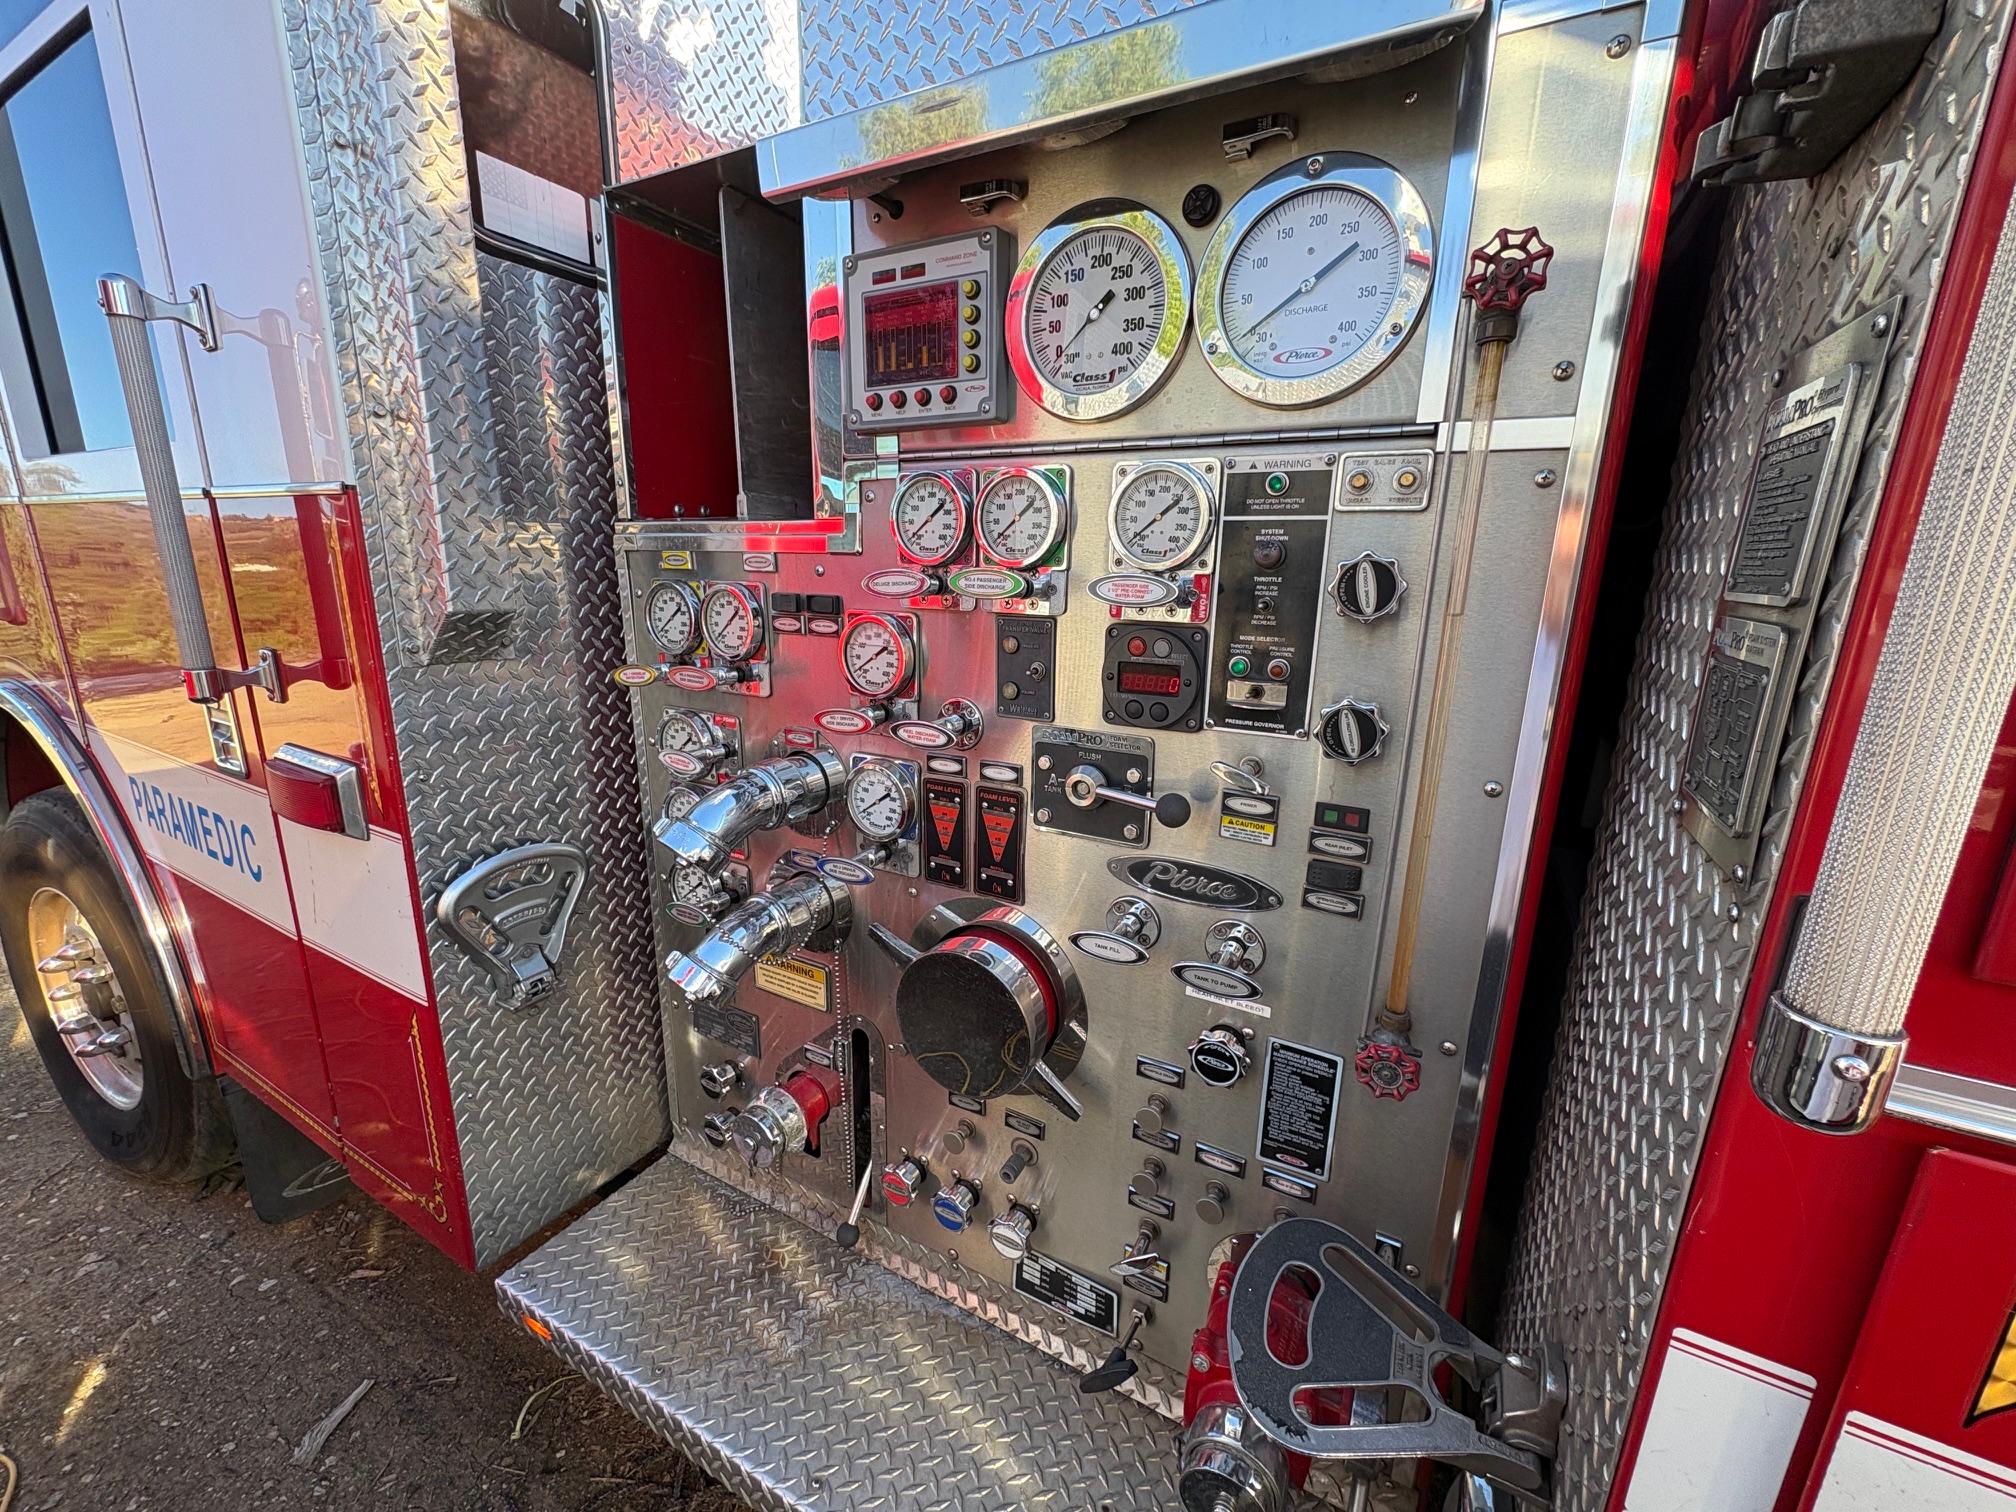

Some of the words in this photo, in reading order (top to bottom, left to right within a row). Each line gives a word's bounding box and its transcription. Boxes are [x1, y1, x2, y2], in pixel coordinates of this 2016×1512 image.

[1309, 214, 1328, 227] 200
[1277, 227, 1293, 240] 150
[1341, 221, 1360, 235] 250
[936, 254, 962, 264] COMMAND
[963, 251, 978, 259] ZONE
[1091, 253, 1112, 269] 200
[1359, 248, 1378, 261] 300
[1252, 257, 1268, 269] 100
[1064, 268, 1084, 283] 150
[1111, 265, 1133, 280] 250
[1124, 286, 1145, 301] 300
[1358, 286, 1377, 299] 350
[1051, 294, 1068, 308] 100
[1241, 294, 1252, 305] 50
[1285, 304, 1328, 317] DISCHARGE
[1049, 320, 1061, 334] 50
[1123, 317, 1144, 332] 350
[1338, 320, 1356, 332] 400
[1056, 345, 1063, 359] 0
[1112, 342, 1133, 356] 400
[1286, 350, 1319, 362] Pierce
[1118, 364, 1128, 375] psi
[1264, 459, 1311, 469] WARNING
[928, 491, 936, 499] 200
[1015, 488, 1025, 496] 200
[1145, 489, 1155, 497] 150
[917, 495, 925, 503] 150
[1169, 677, 1179, 692] 0
[1254, 721, 1285, 729] GOVERNOR
[915, 731, 940, 739] DISCHARGE
[1326, 727, 1334, 745] OPEN
[1110, 742, 1141, 751] SELECTOR
[1079, 752, 1101, 760] FLUSH
[1049, 774, 1058, 785] A
[944, 786, 961, 794] LEVEL
[1044, 785, 1062, 794] TANK
[980, 792, 998, 801] FOAM
[999, 795, 1017, 804] LEVEL
[128, 775, 262, 883] PARAMEDIC
[1235, 820, 1266, 831] CAUTION
[1143, 861, 1237, 899] Pierce
[1094, 942, 1108, 951] TANK
[1109, 946, 1121, 954] FILL
[1194, 974, 1209, 984] TANK
[1220, 981, 1238, 991] PUMP
